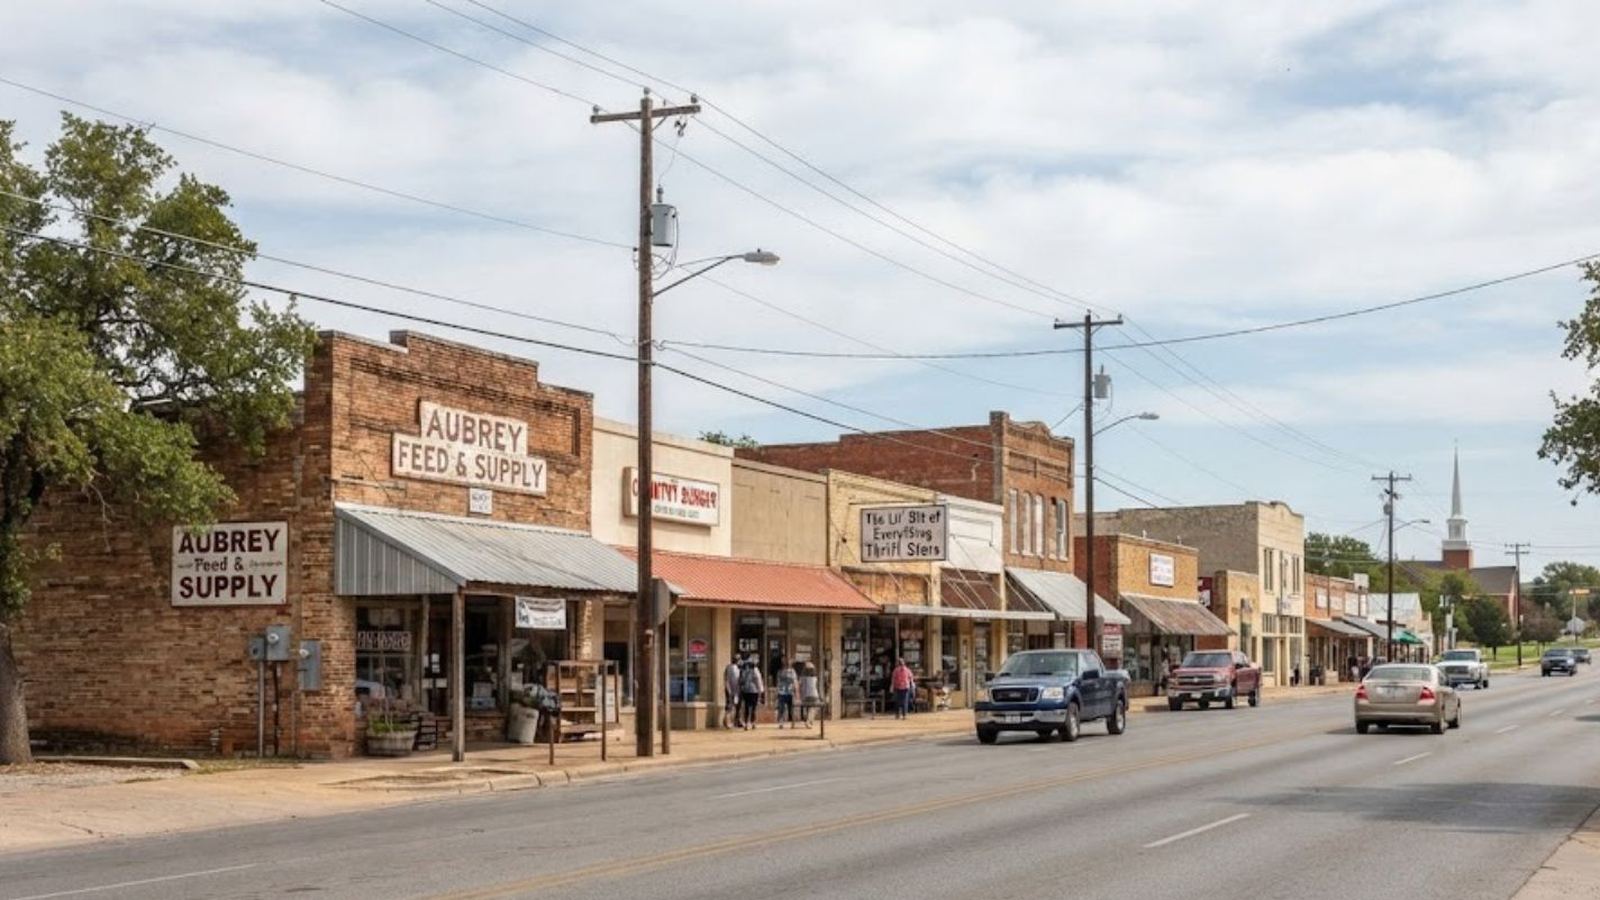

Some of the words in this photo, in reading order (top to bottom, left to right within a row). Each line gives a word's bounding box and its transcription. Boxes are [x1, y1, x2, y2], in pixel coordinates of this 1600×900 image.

[426, 408, 522, 453] AUBREY
[398, 441, 449, 474] FEED
[455, 451, 467, 477] &
[475, 453, 543, 488] SUPPLY
[178, 528, 280, 554] AUBREY
[194, 556, 228, 572] Feed
[234, 556, 244, 572] &
[180, 574, 278, 599] SUPPLY
